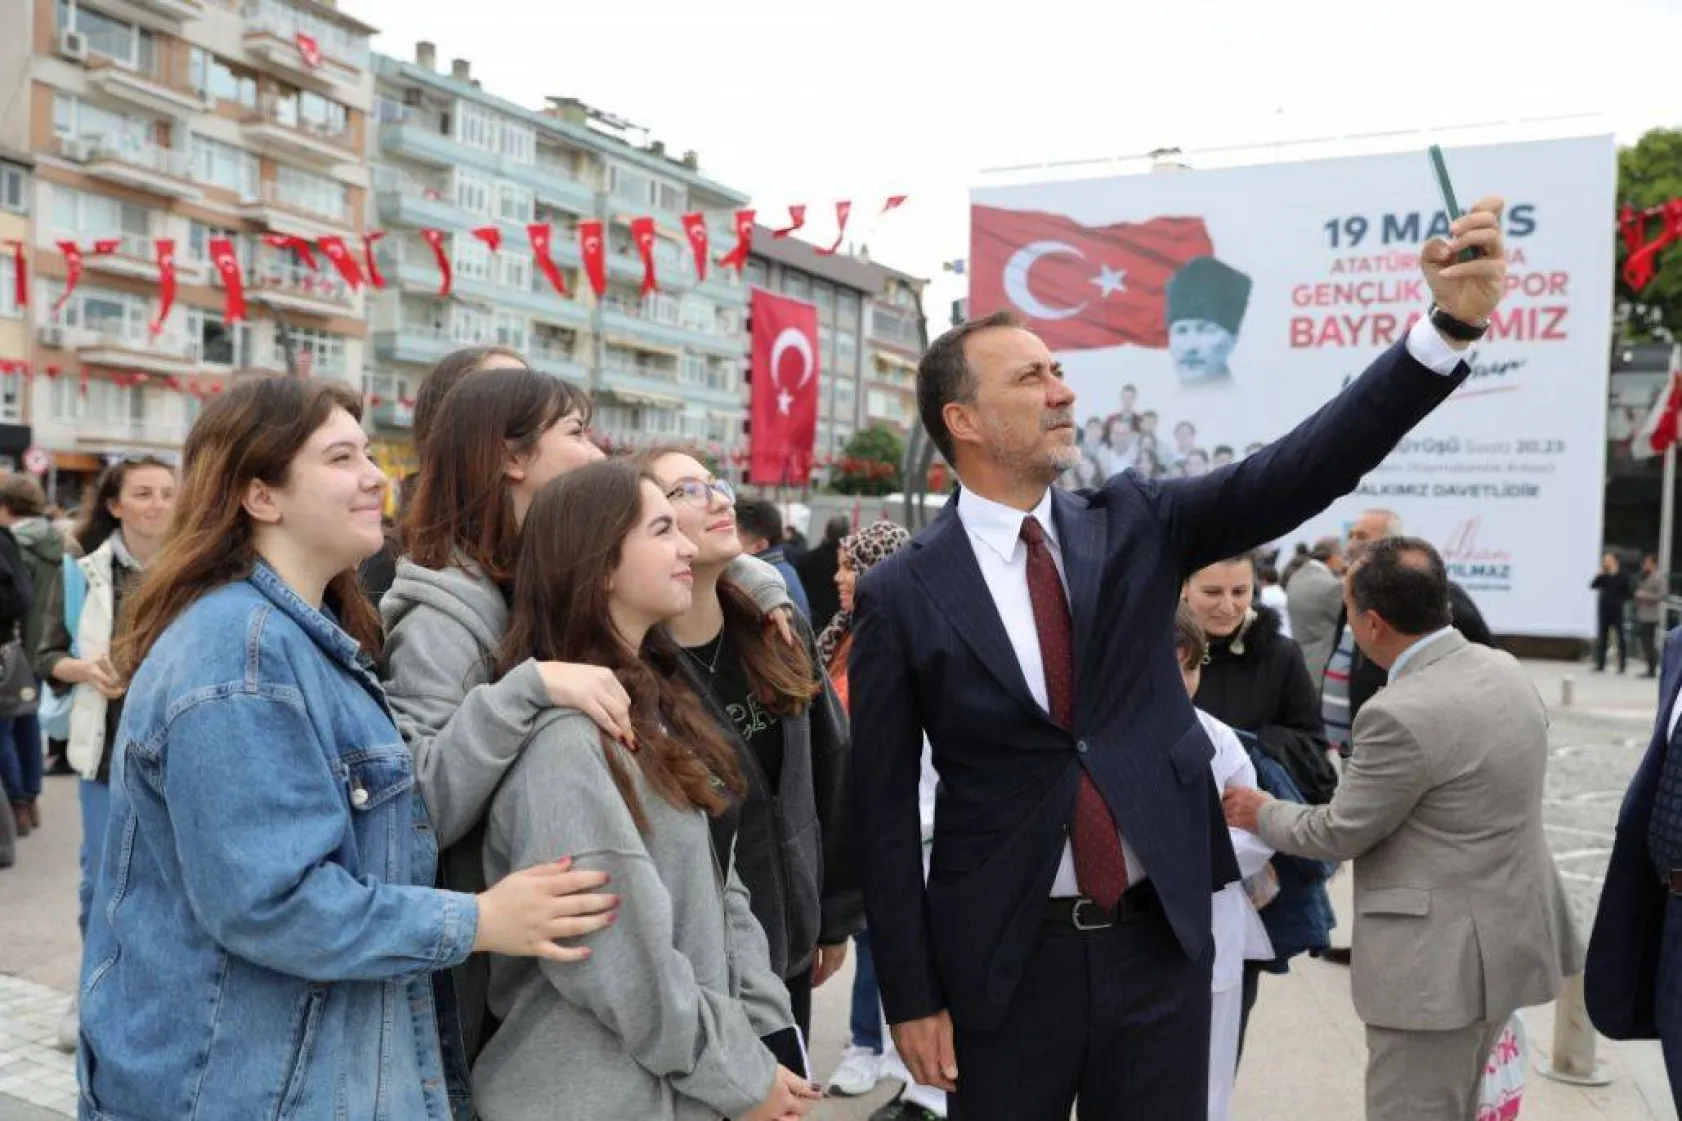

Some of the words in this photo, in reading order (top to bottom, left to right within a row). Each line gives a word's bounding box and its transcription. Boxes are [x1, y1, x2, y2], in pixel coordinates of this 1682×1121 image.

[1324, 215, 1369, 248] 19
[1382, 203, 1537, 245] MAS
[1329, 250, 1420, 275] ATATÜR
[1502, 271, 1569, 300] POR
[1289, 305, 1569, 349] BAYRMIZ
[1357, 482, 1430, 498] ALKIMIZ
